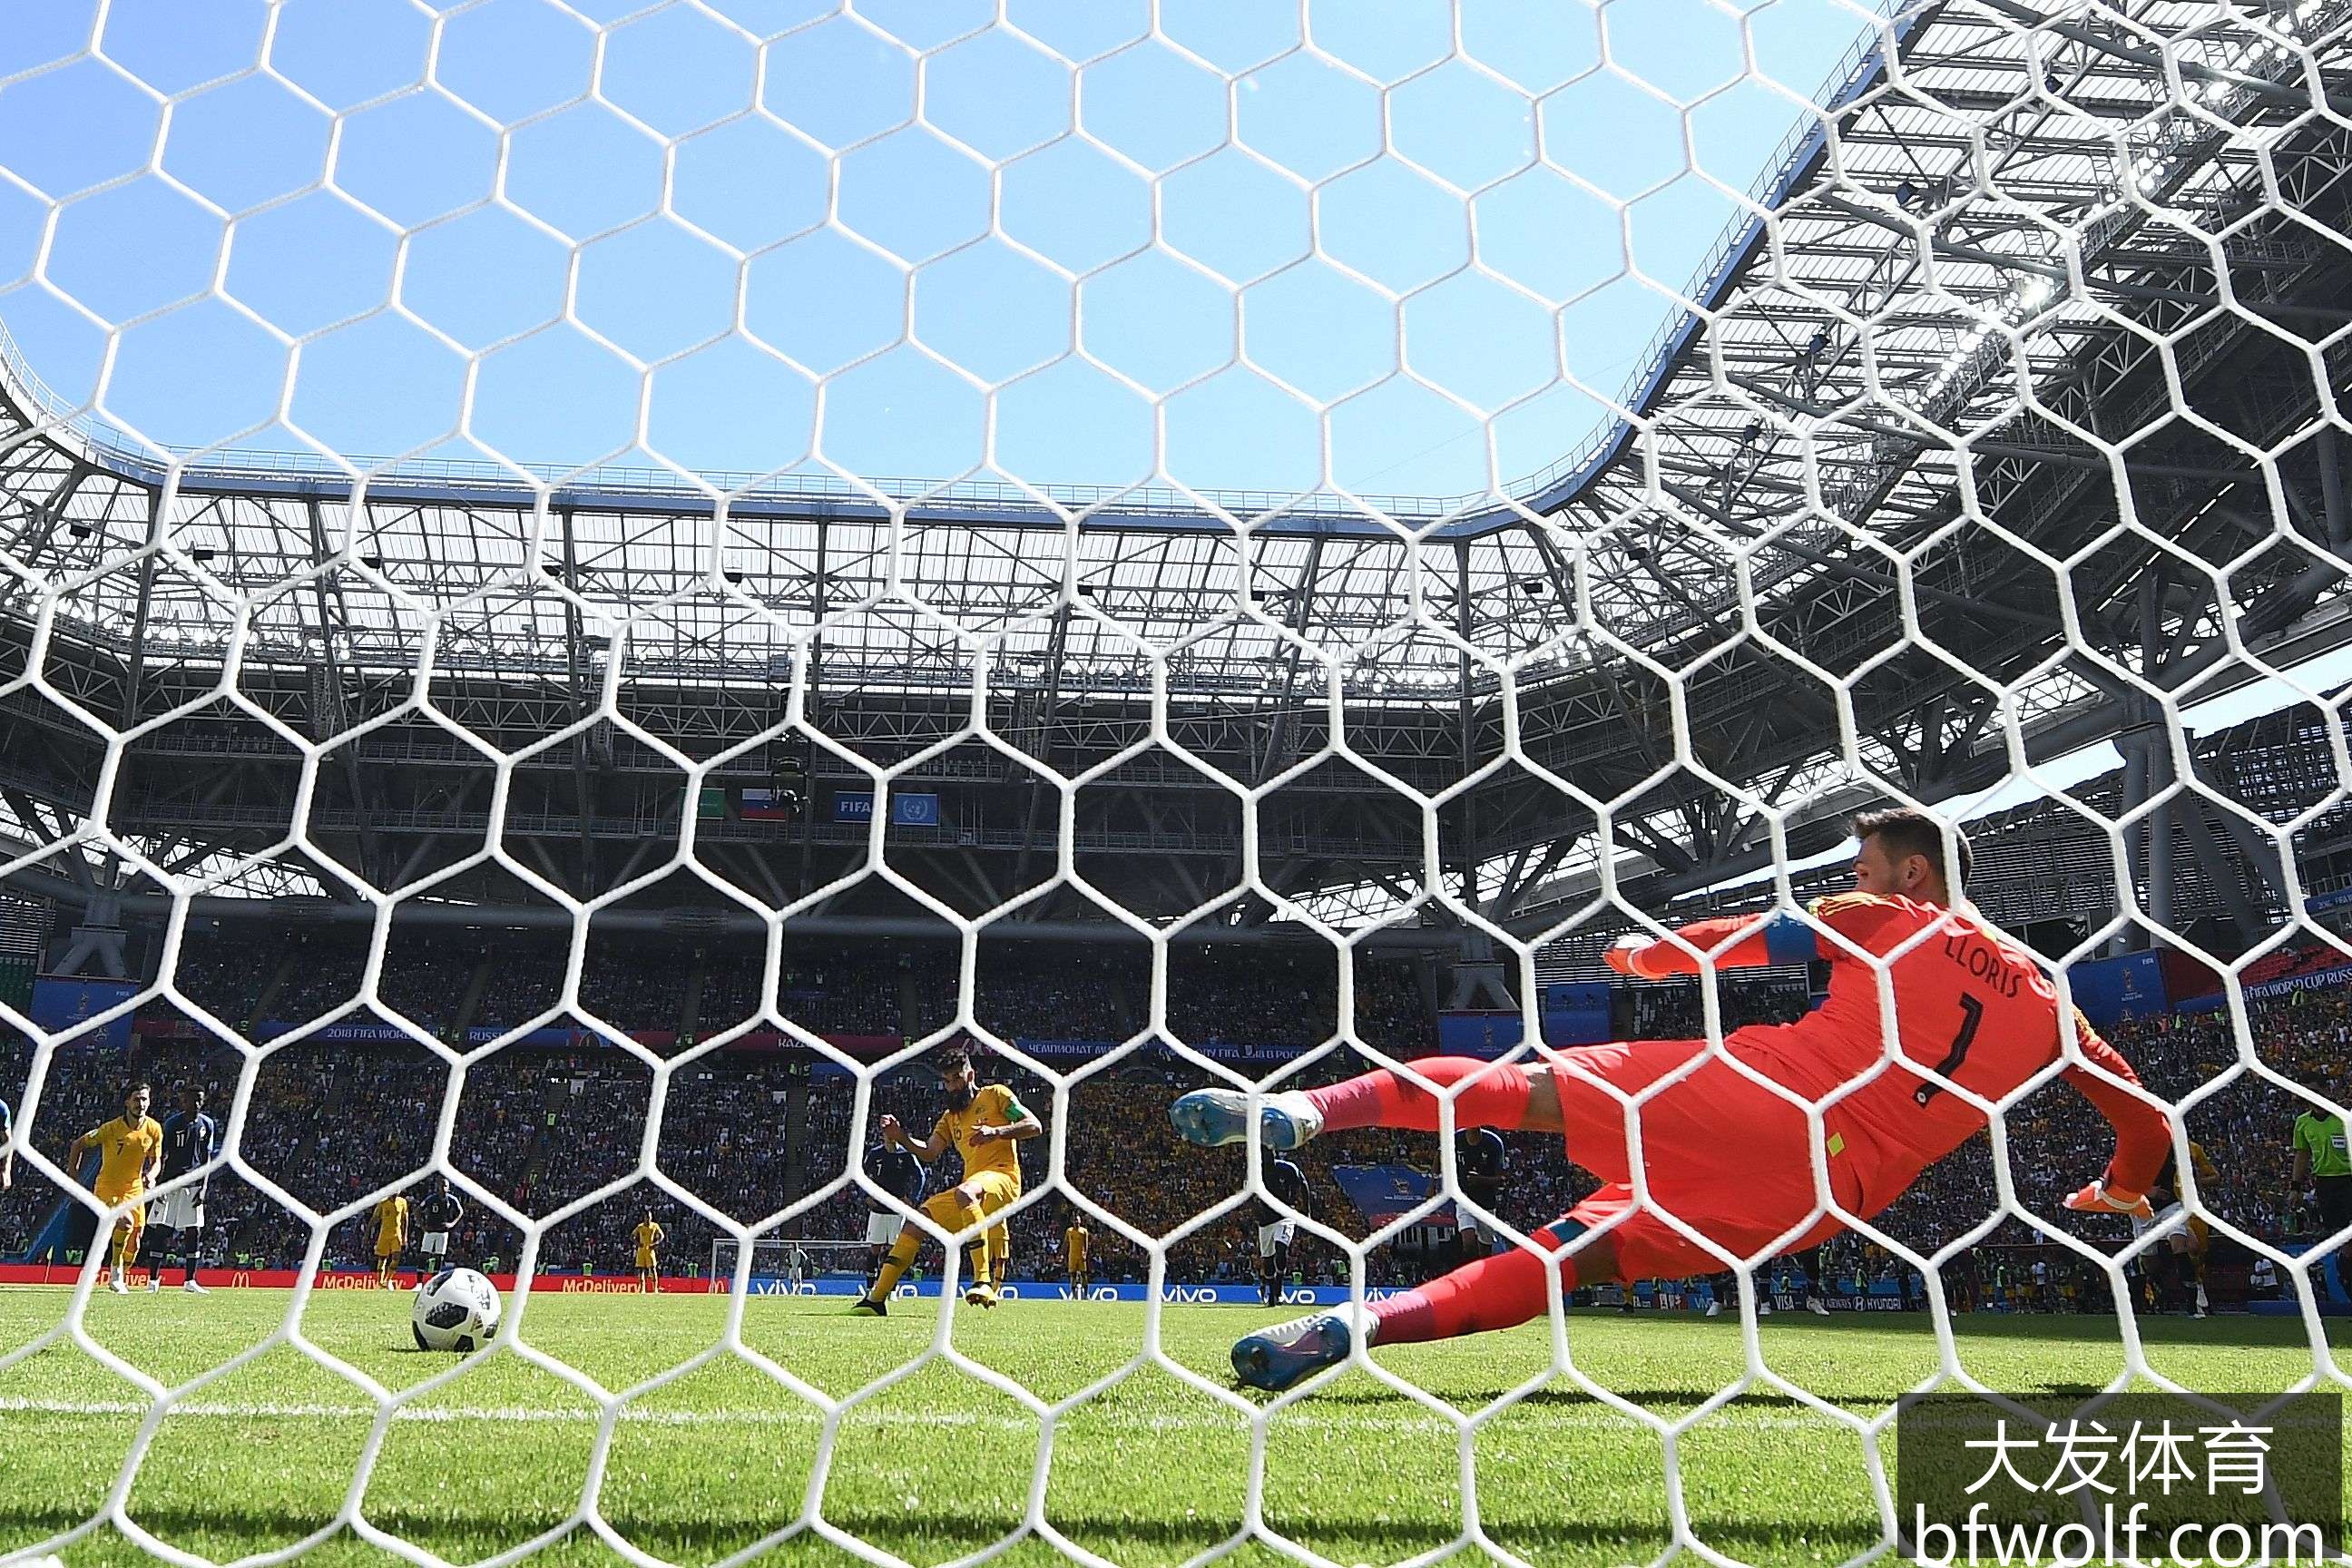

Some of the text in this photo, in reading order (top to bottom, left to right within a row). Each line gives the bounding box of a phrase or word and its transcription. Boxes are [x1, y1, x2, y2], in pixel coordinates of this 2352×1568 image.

[840, 800, 872, 814] FIFA
[1945, 936, 2023, 998] LLORIS
[2249, 985, 2269, 1000] FIFA
[2305, 974, 2326, 989] CUP
[327, 1028, 411, 1040] 2018 FIFA WORL
[468, 1031, 503, 1042] RUSS
[1028, 1044, 1092, 1054] ЧЕМПИОНАТ
[116, 1141, 124, 1156] 7
[877, 1163, 882, 1176] 7
[562, 1278, 642, 1293] McDelivery
[1161, 1284, 1217, 1303] vivo
[1774, 1294, 1795, 1311] VISA
[1867, 1298, 1903, 1310] HYUNDAI
